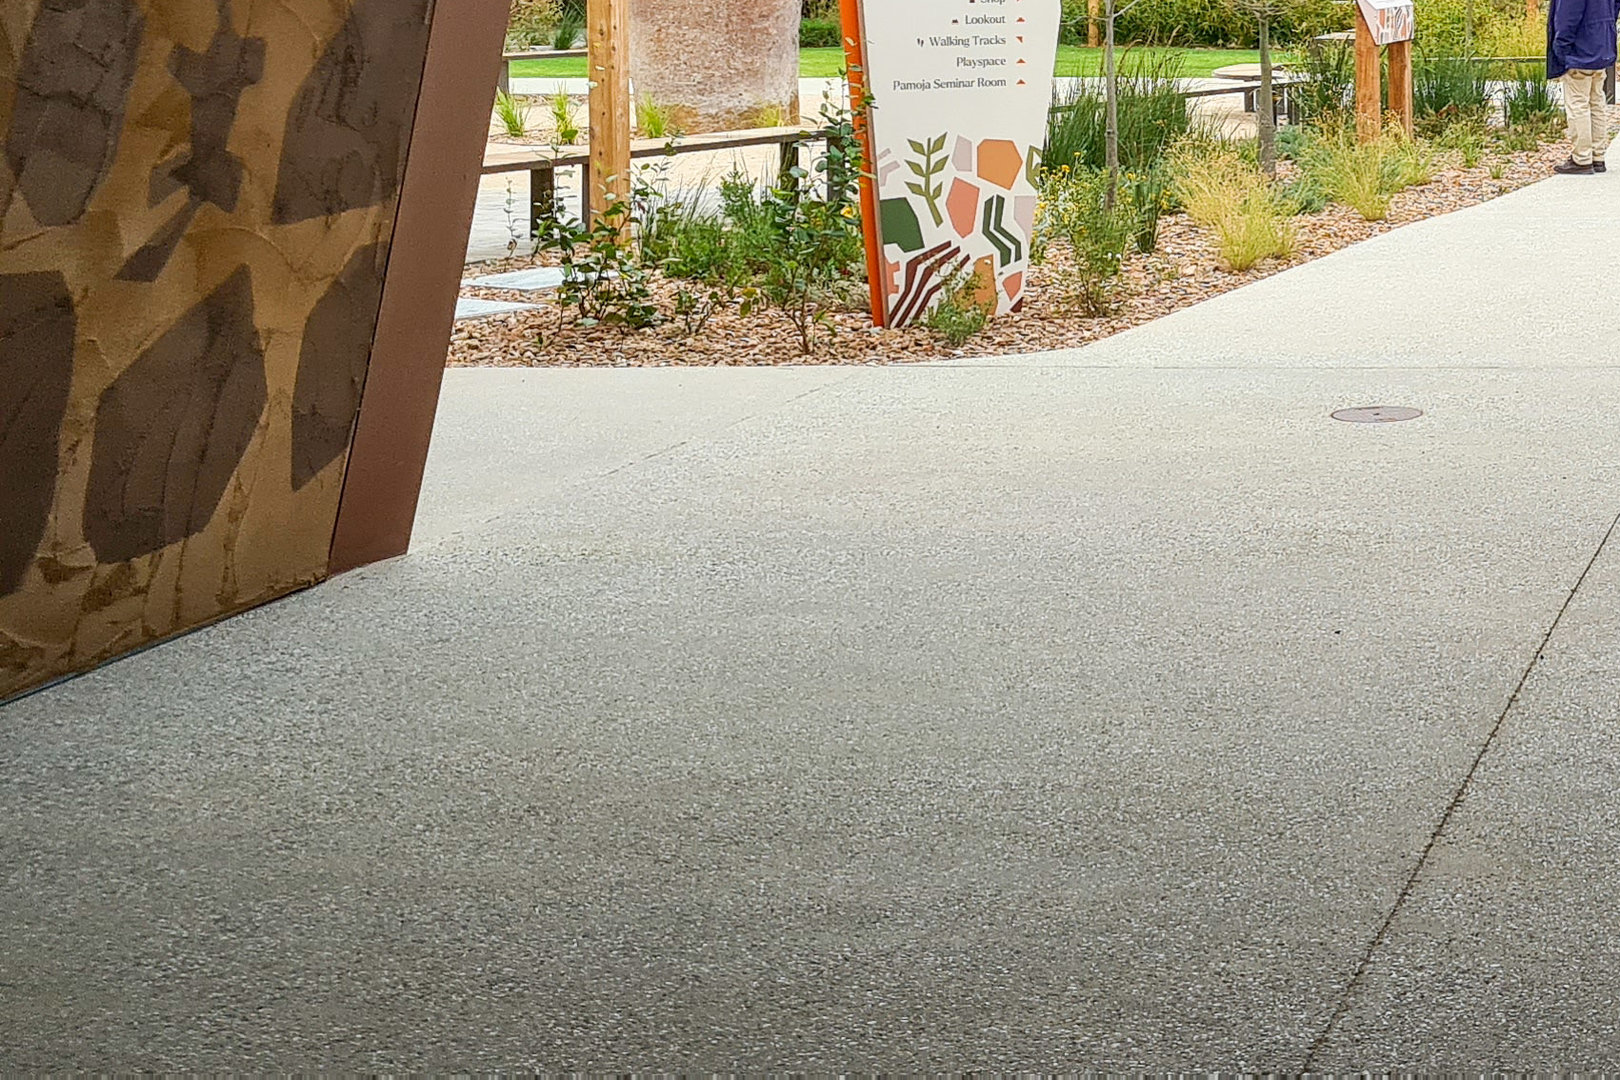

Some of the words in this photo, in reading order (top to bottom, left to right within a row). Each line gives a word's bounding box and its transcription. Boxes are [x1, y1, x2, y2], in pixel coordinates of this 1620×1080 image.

[965, 15, 1006, 25] Lookout
[929, 36, 970, 48] Walking
[973, 35, 1006, 45] Tracks
[956, 57, 1007, 69] Playspace
[893, 80, 931, 91] Pamoja
[933, 79, 974, 89] Seminar
[977, 78, 1007, 87] Room
